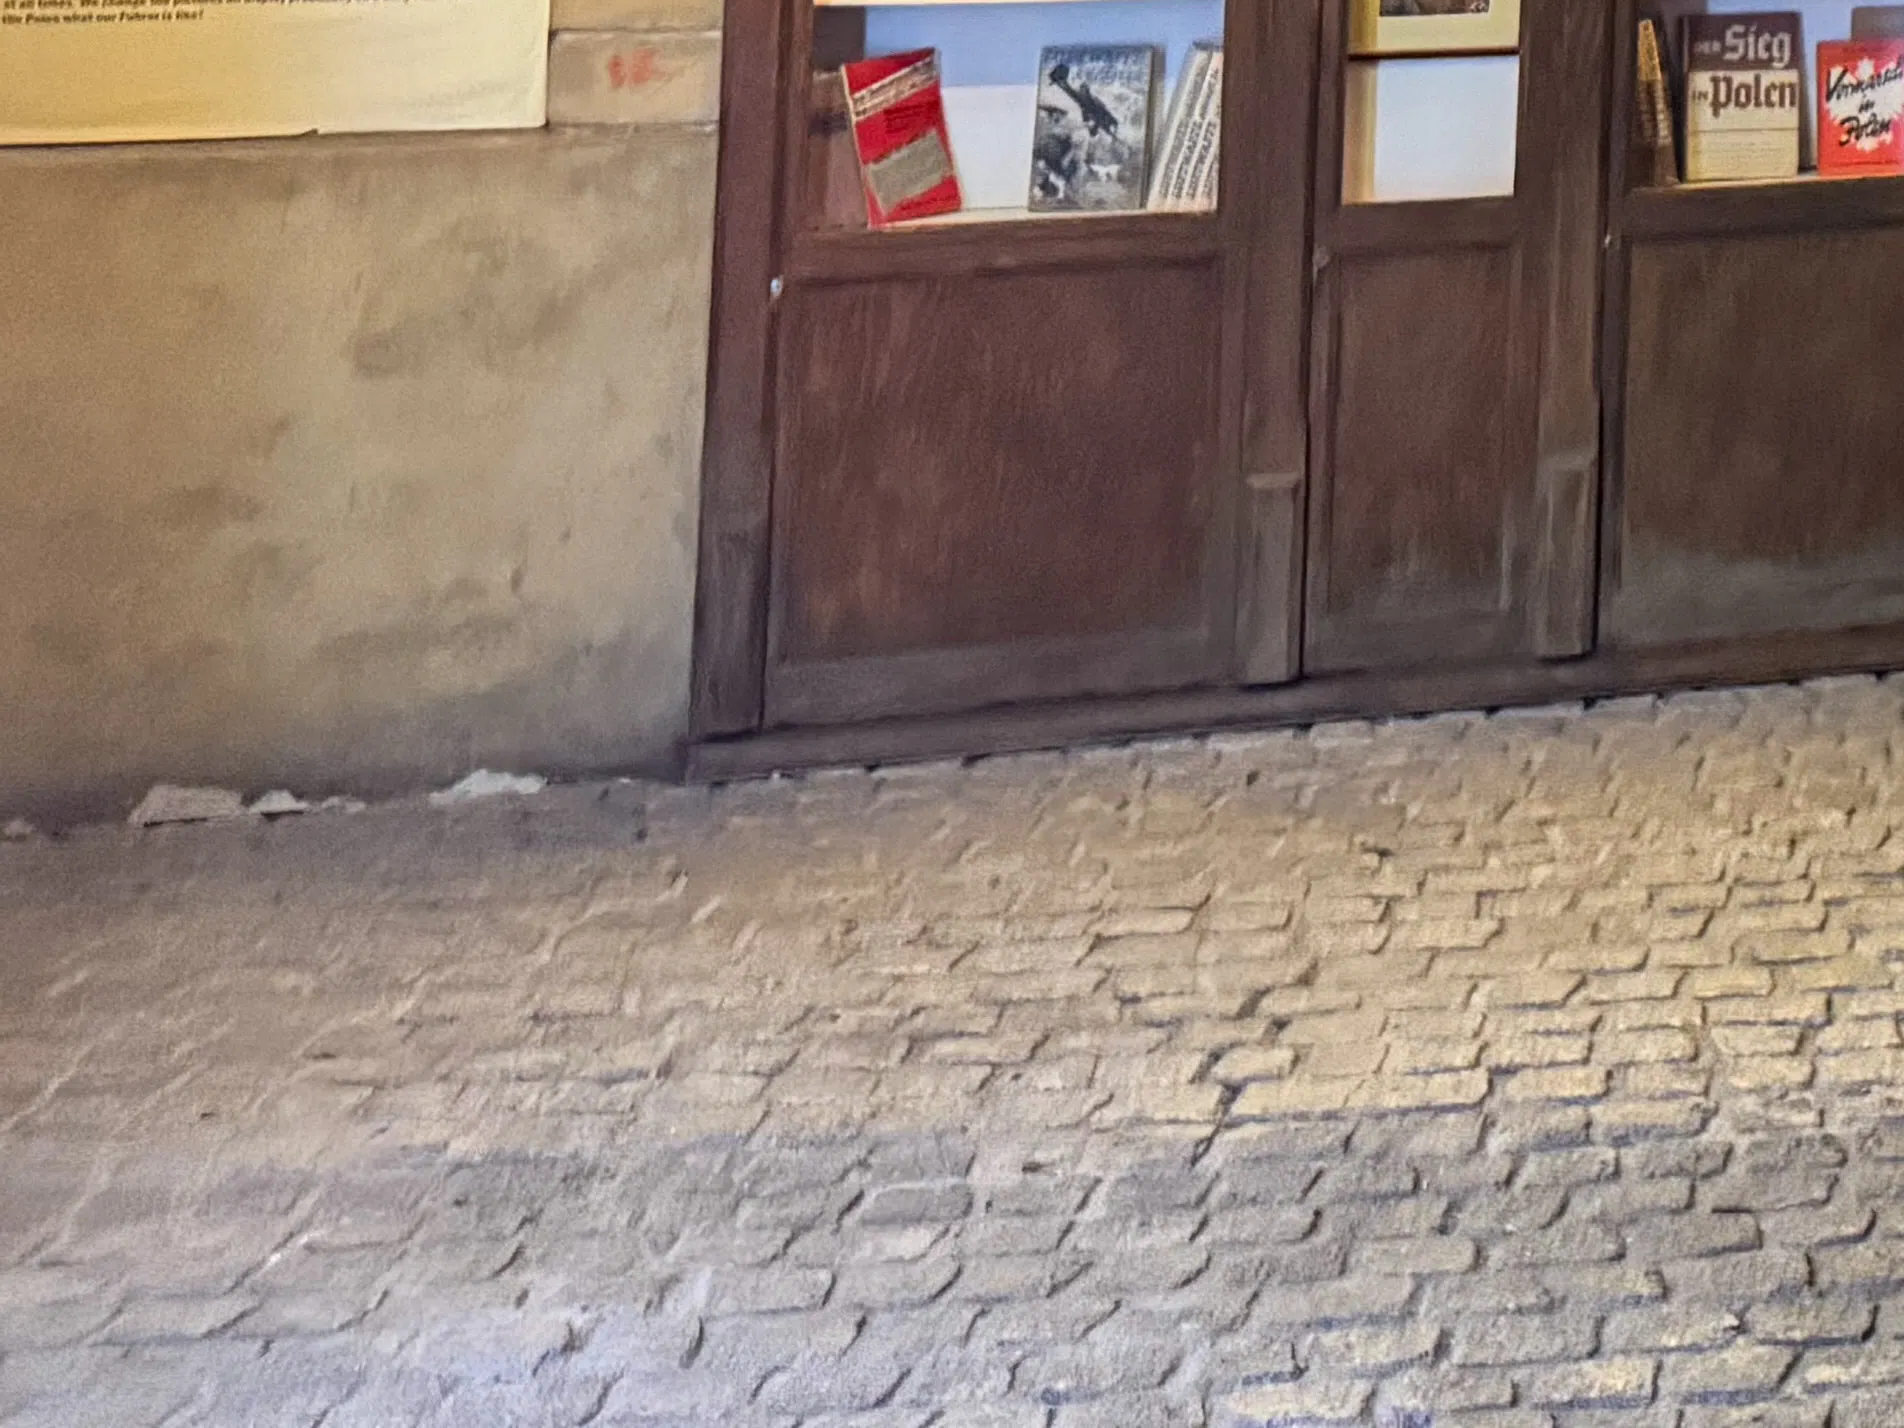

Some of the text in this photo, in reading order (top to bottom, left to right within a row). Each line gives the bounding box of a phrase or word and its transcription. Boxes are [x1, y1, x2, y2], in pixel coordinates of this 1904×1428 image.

[1722, 22, 1793, 67] Sieg
[1710, 73, 1797, 119] Polen
[1858, 95, 1876, 114] in
[1838, 110, 1892, 148] Polen
